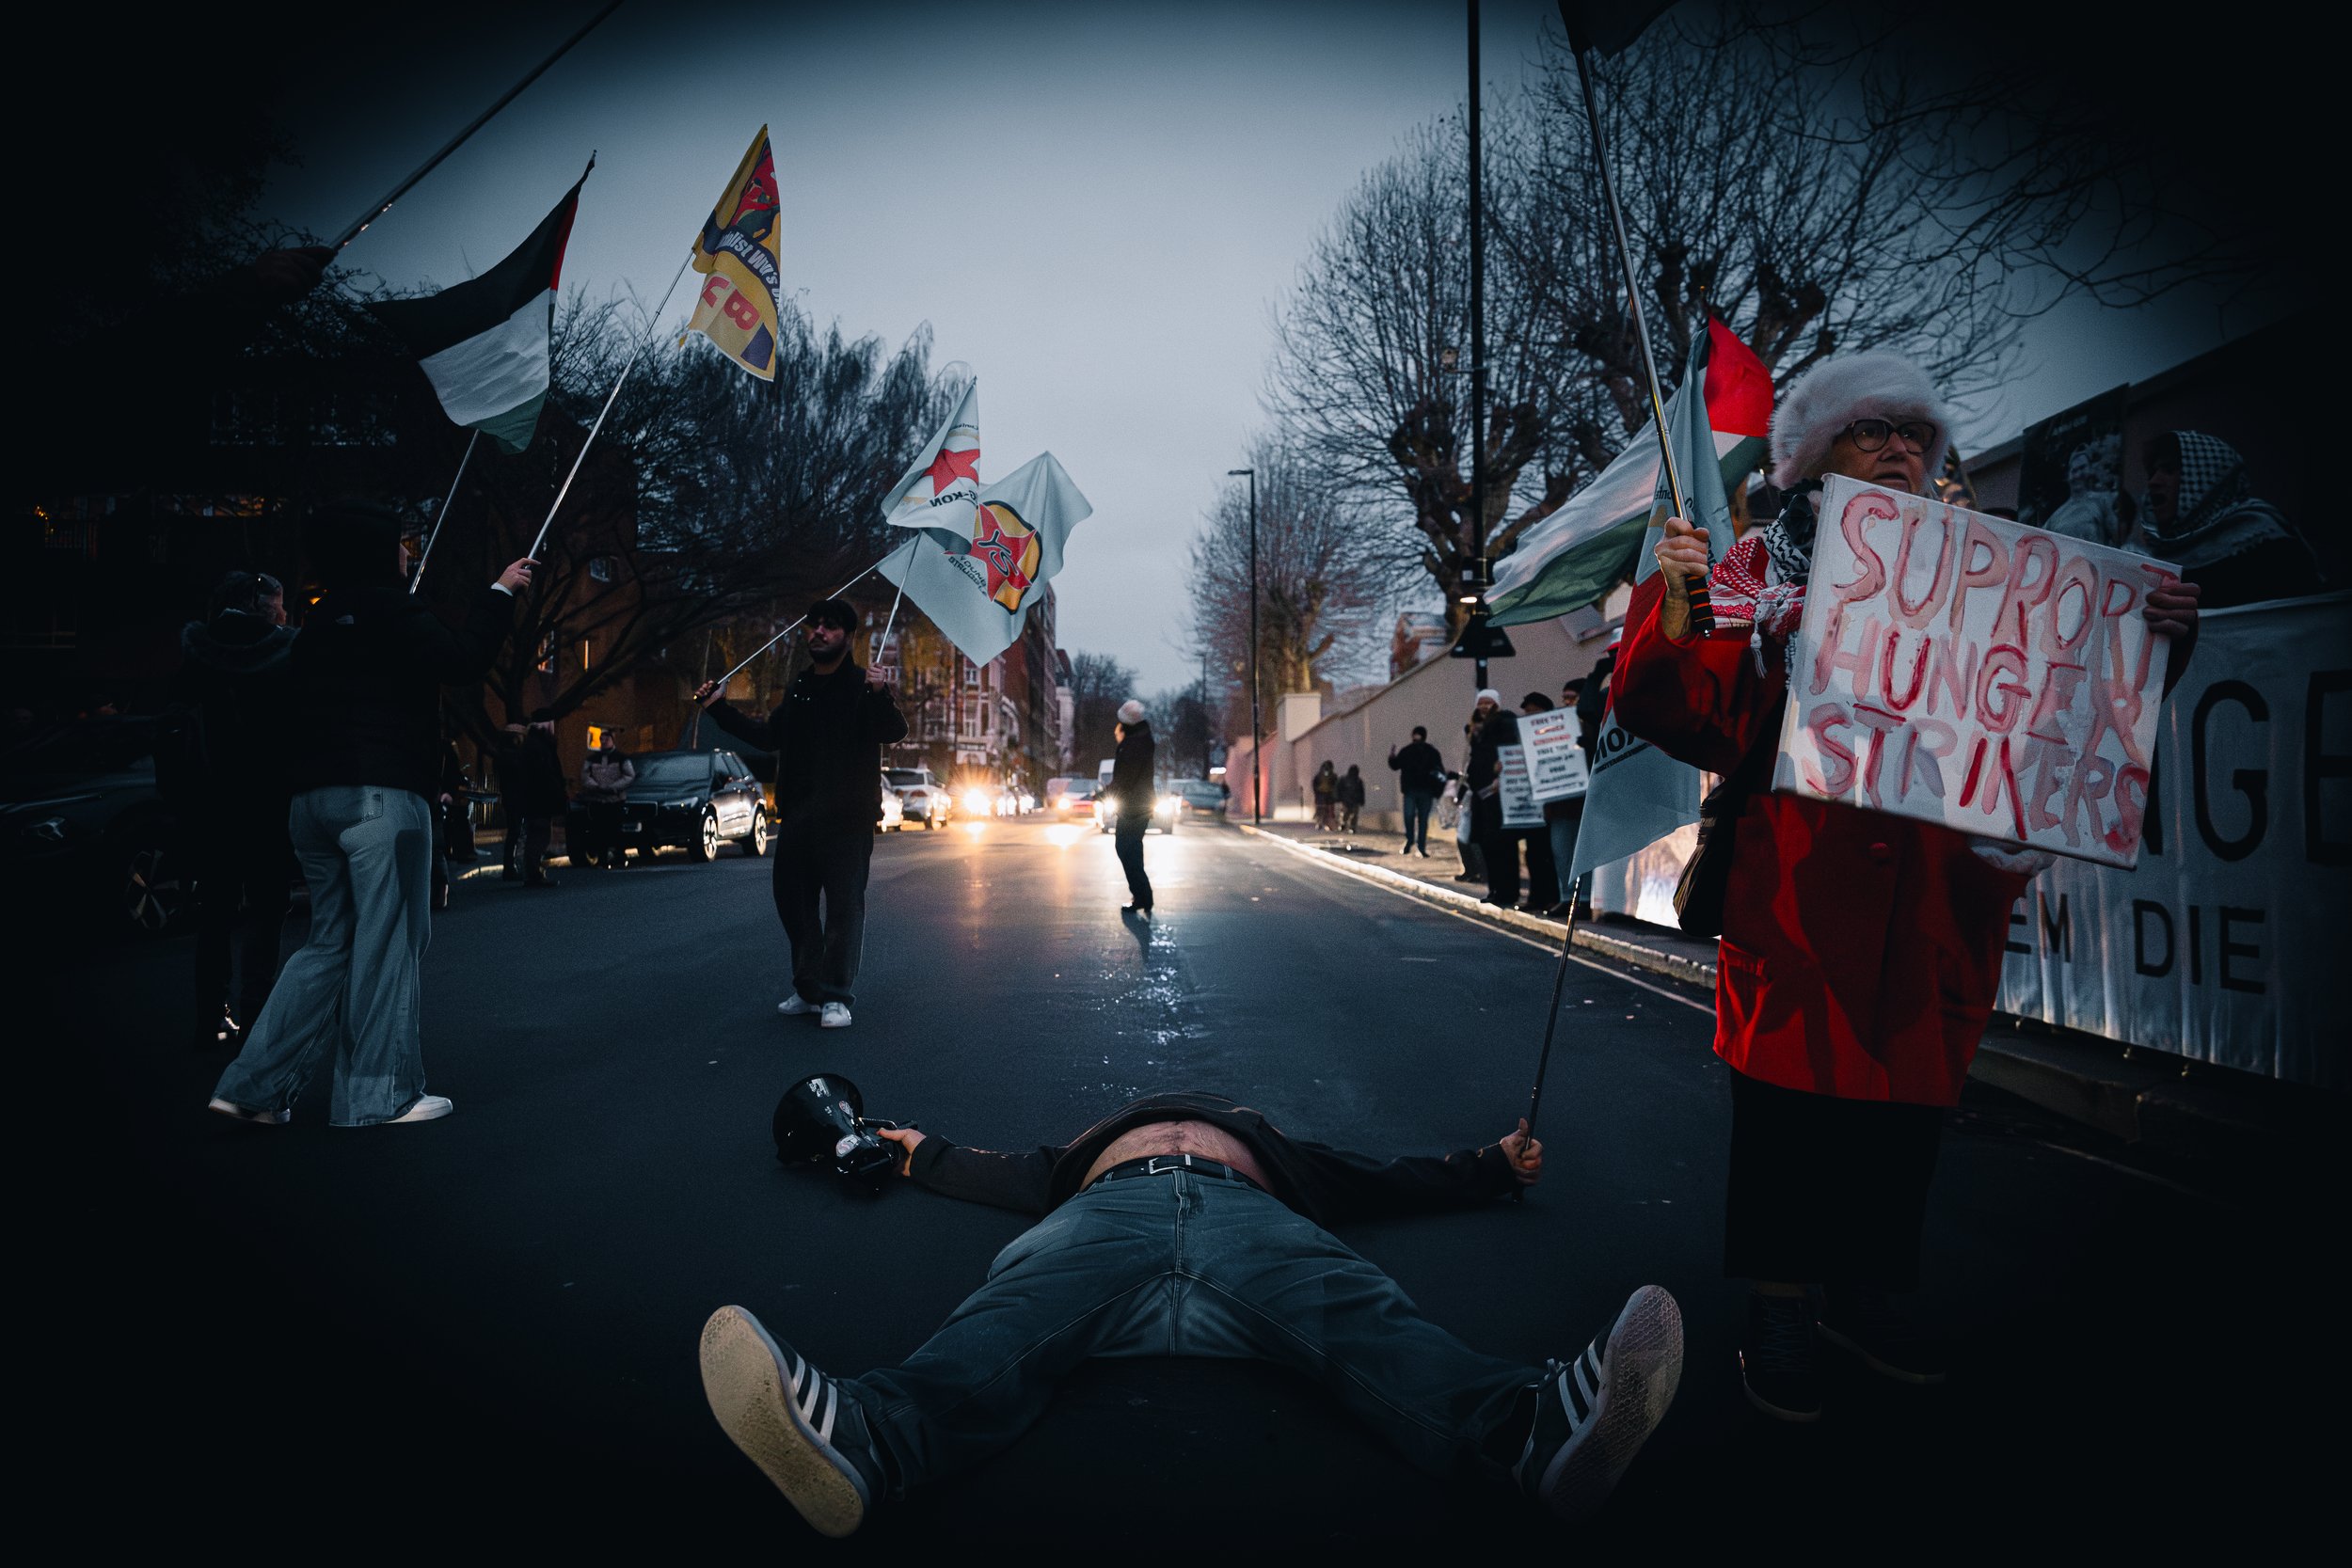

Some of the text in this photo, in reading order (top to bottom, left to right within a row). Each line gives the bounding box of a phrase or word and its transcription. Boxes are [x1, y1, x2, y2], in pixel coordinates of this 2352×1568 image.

[1810, 607, 2149, 764] HUNGER
[1807, 702, 2149, 854] STRIKERS
[2142, 668, 2352, 867] GE
[2133, 899, 2265, 994] DIE
